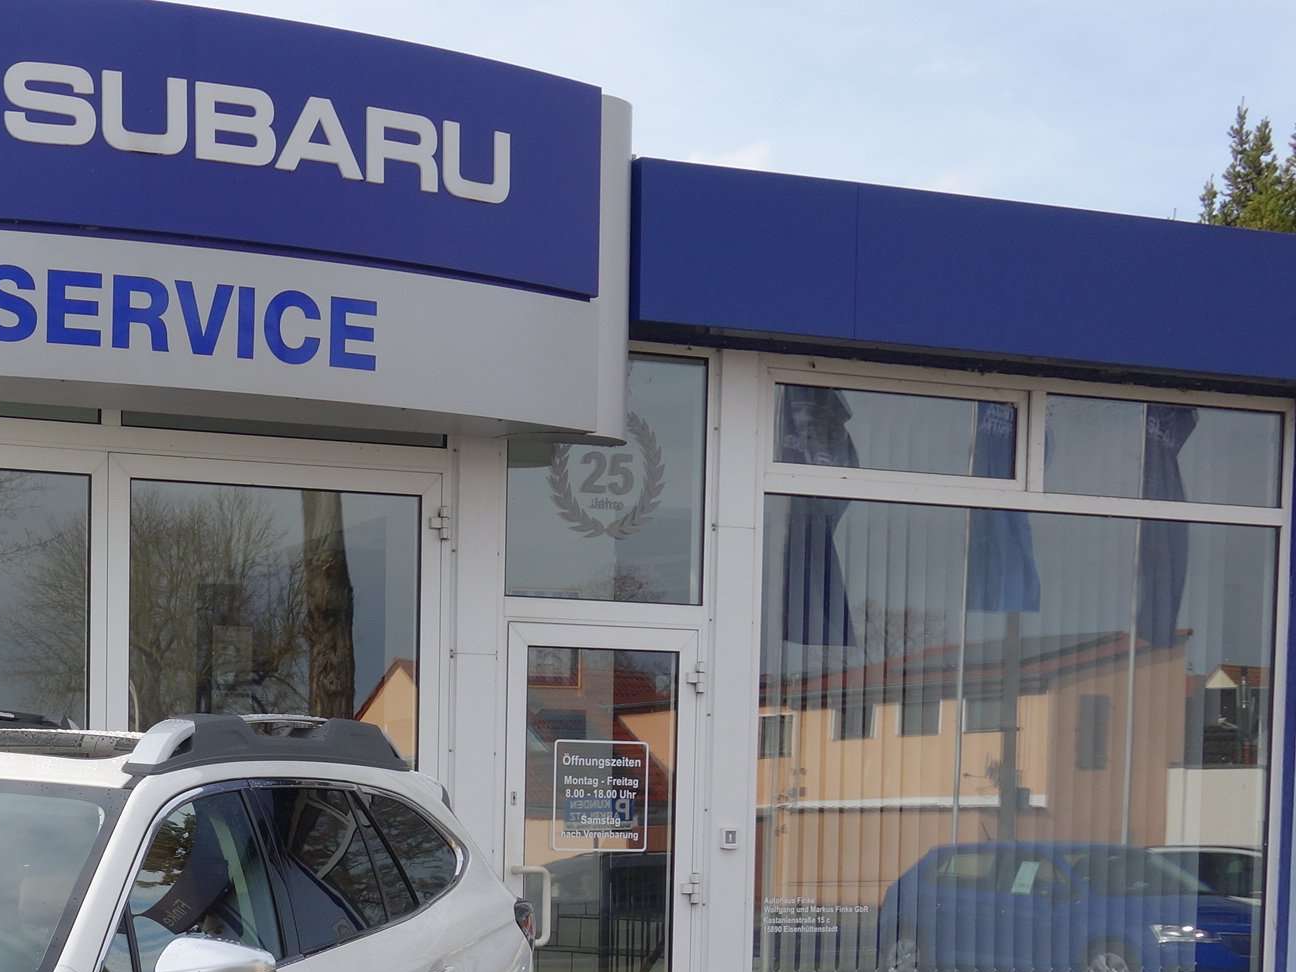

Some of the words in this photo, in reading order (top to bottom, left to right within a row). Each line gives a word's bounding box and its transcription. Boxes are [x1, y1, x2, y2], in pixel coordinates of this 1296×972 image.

[4, 62, 510, 204] SUBARU
[580, 451, 634, 495] 25
[562, 752, 641, 768] Öffnungszeiten
[564, 776, 599, 788] Montag
[607, 776, 639, 789] Freitag
[565, 789, 584, 799] 8.00
[593, 789, 617, 799] 18.00
[619, 790, 637, 800] Uhr
[581, 815, 621, 827] Samstag
[561, 830, 581, 838] nach
[583, 830, 639, 841] Vereinbarung
[764, 905, 795, 914] Wolfgang
[854, 905, 869, 913] GbR
